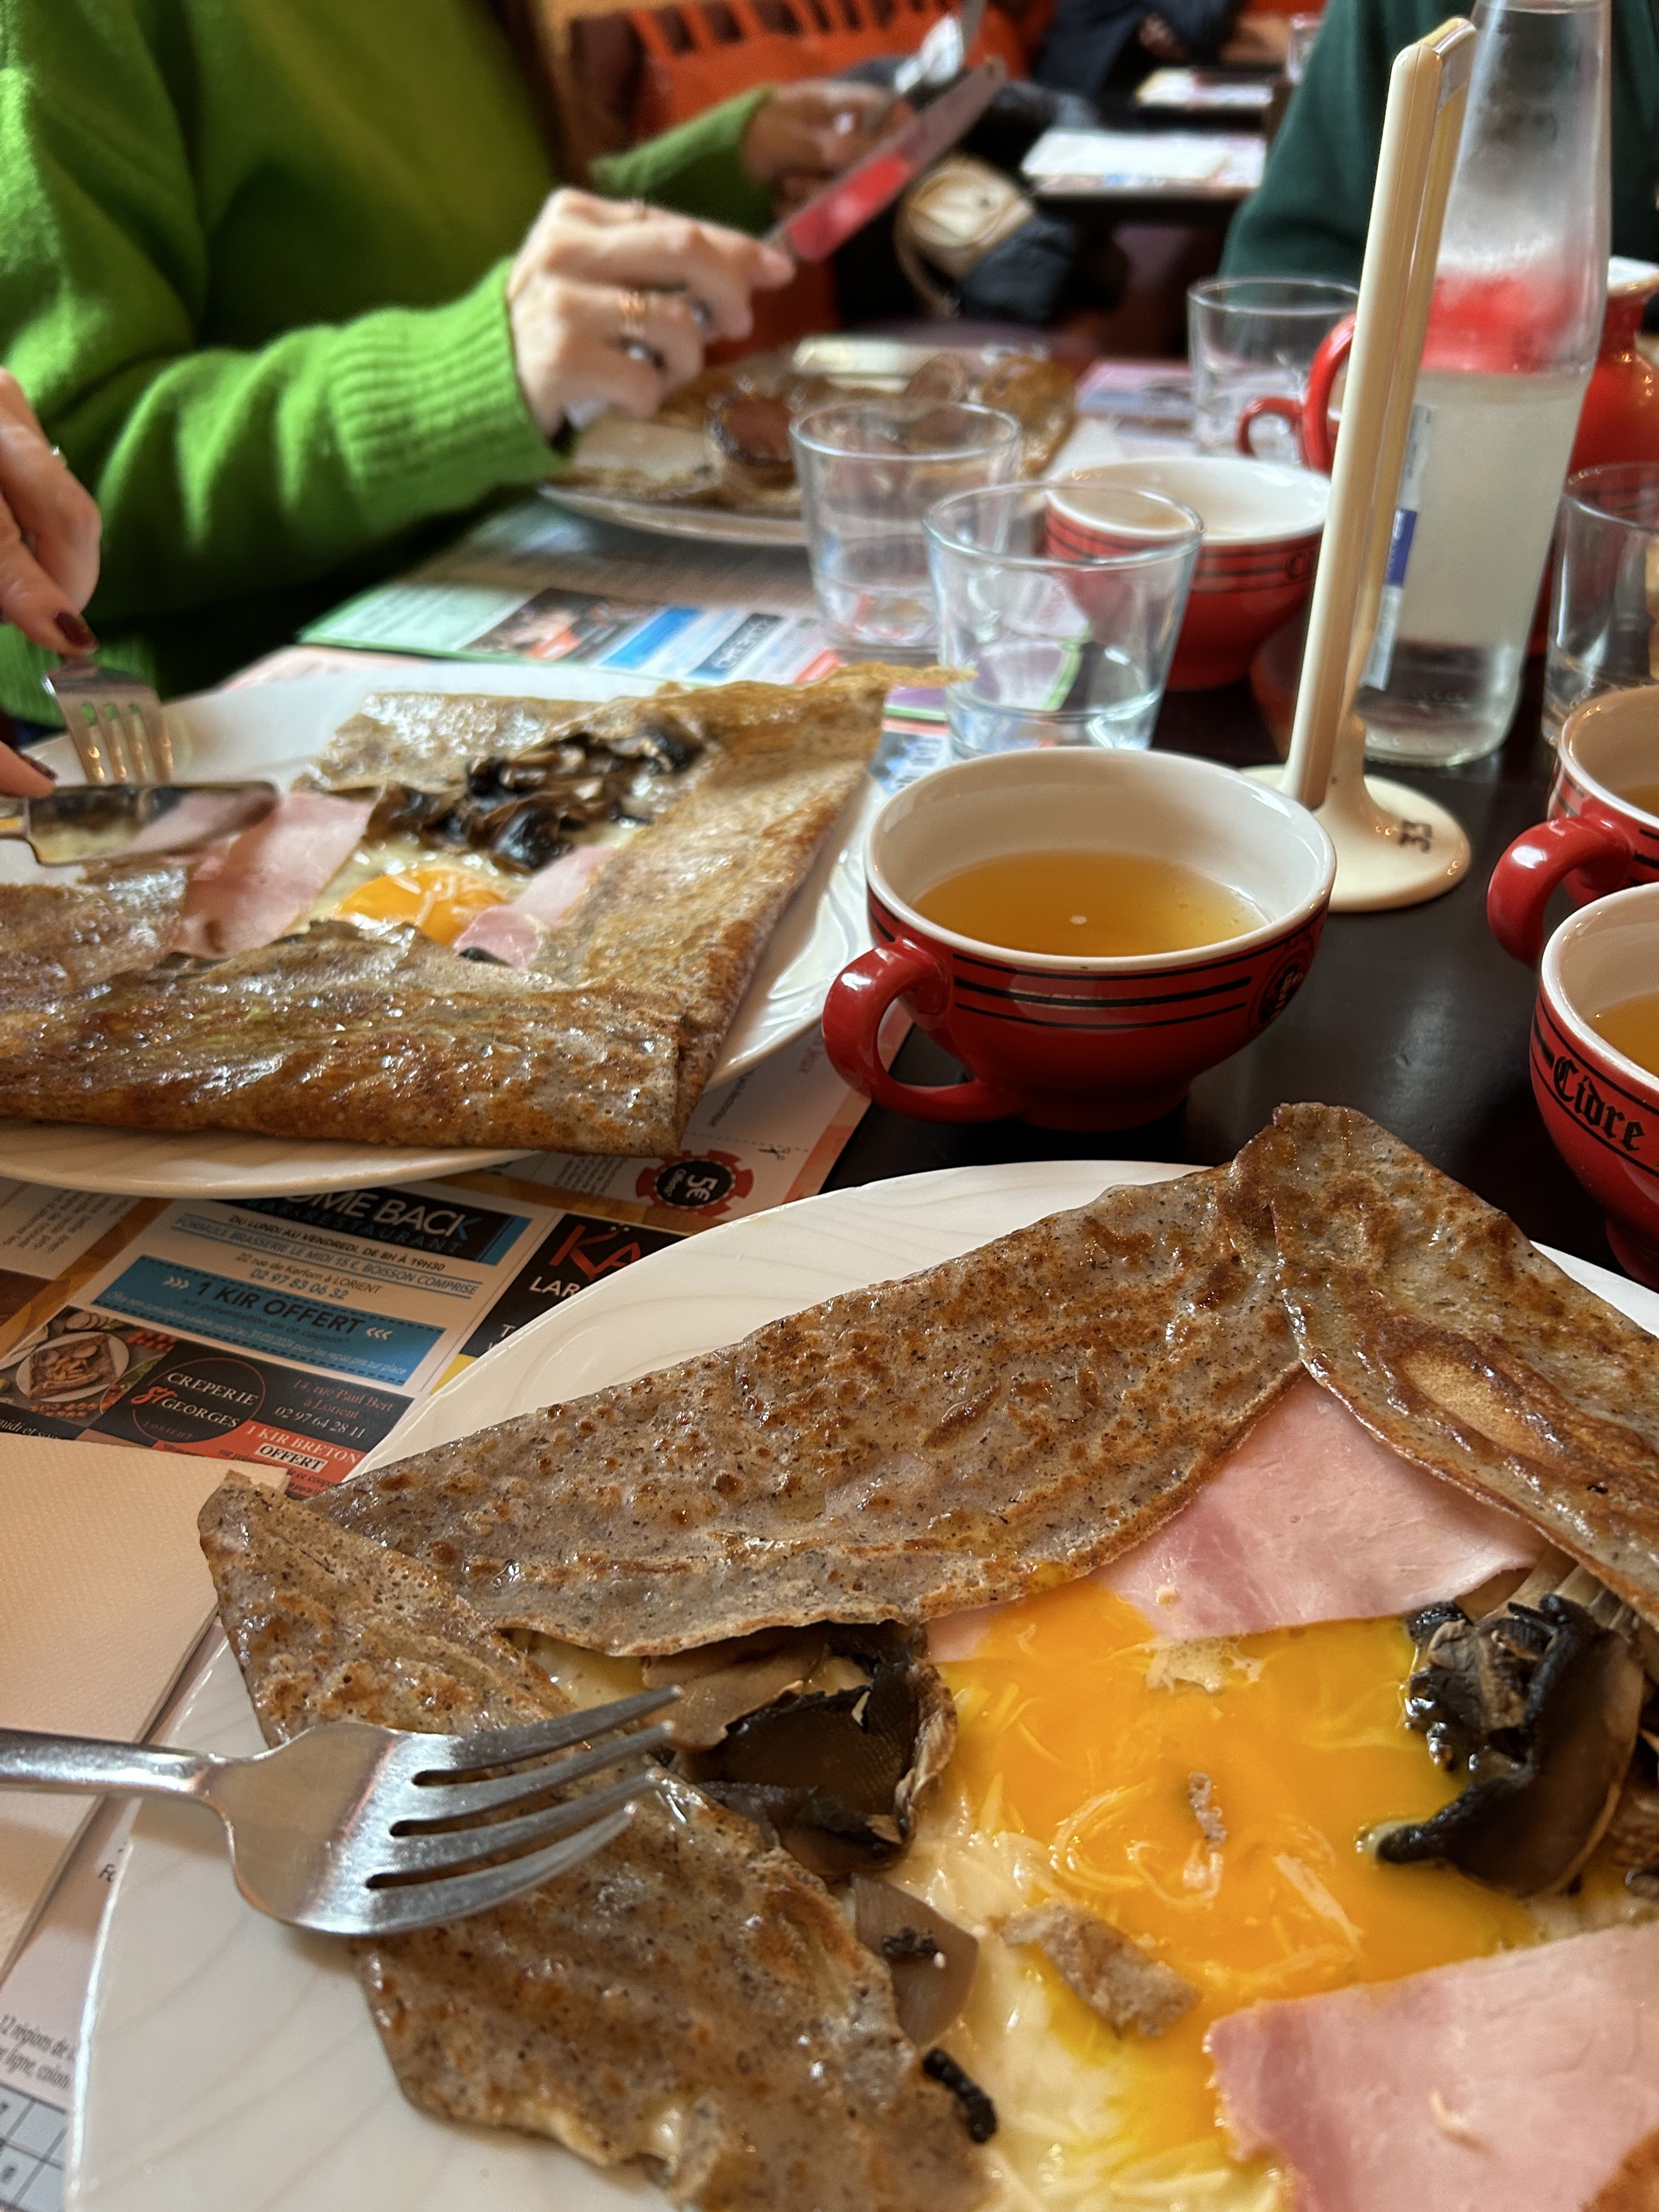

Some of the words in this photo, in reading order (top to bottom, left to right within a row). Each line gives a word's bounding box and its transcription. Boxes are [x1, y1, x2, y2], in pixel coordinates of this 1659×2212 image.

[1554, 1056, 1645, 1152] Cidre
[686, 1175, 719, 1201] 5€
[373, 1198, 483, 1241] BACK
[229, 1215, 246, 1225] DU
[248, 1221, 284, 1234] LUNDI
[283, 1229, 302, 1239] AU
[362, 1246, 379, 1259] DE
[380, 1251, 398, 1262] 8H
[410, 1257, 446, 1272] 19H30
[229, 1231, 291, 1252] BRASSERIE
[305, 1250, 334, 1263] MIDI
[363, 1262, 416, 1283] BOISSON
[416, 1276, 479, 1295] COMPRISE
[250, 1268, 270, 1280] 02
[252, 1257, 269, 1267] rue
[270, 1261, 284, 1271] de
[332, 1276, 383, 1294] LORIENT
[530, 1276, 589, 1297] LAR
[198, 1280, 212, 1296] 1
[214, 1286, 261, 1310] KIR
[263, 1299, 366, 1334] OFFERT
[167, 1372, 258, 1406] CREPERIE
[303, 1397, 313, 1408] à
[312, 1385, 335, 1396] rue
[335, 1389, 365, 1405] Paul
[365, 1396, 394, 1412] Bert
[161, 1397, 241, 1428] GEORGES
[274, 1406, 295, 1419] 02
[294, 1410, 313, 1423] 97
[312, 1417, 330, 1429] 64
[329, 1420, 349, 1433] 28
[349, 1426, 366, 1438] 11
[258, 1428, 290, 1445] KIR
[291, 1438, 360, 1464] BRETON
[259, 1444, 325, 1470] OFFERT
